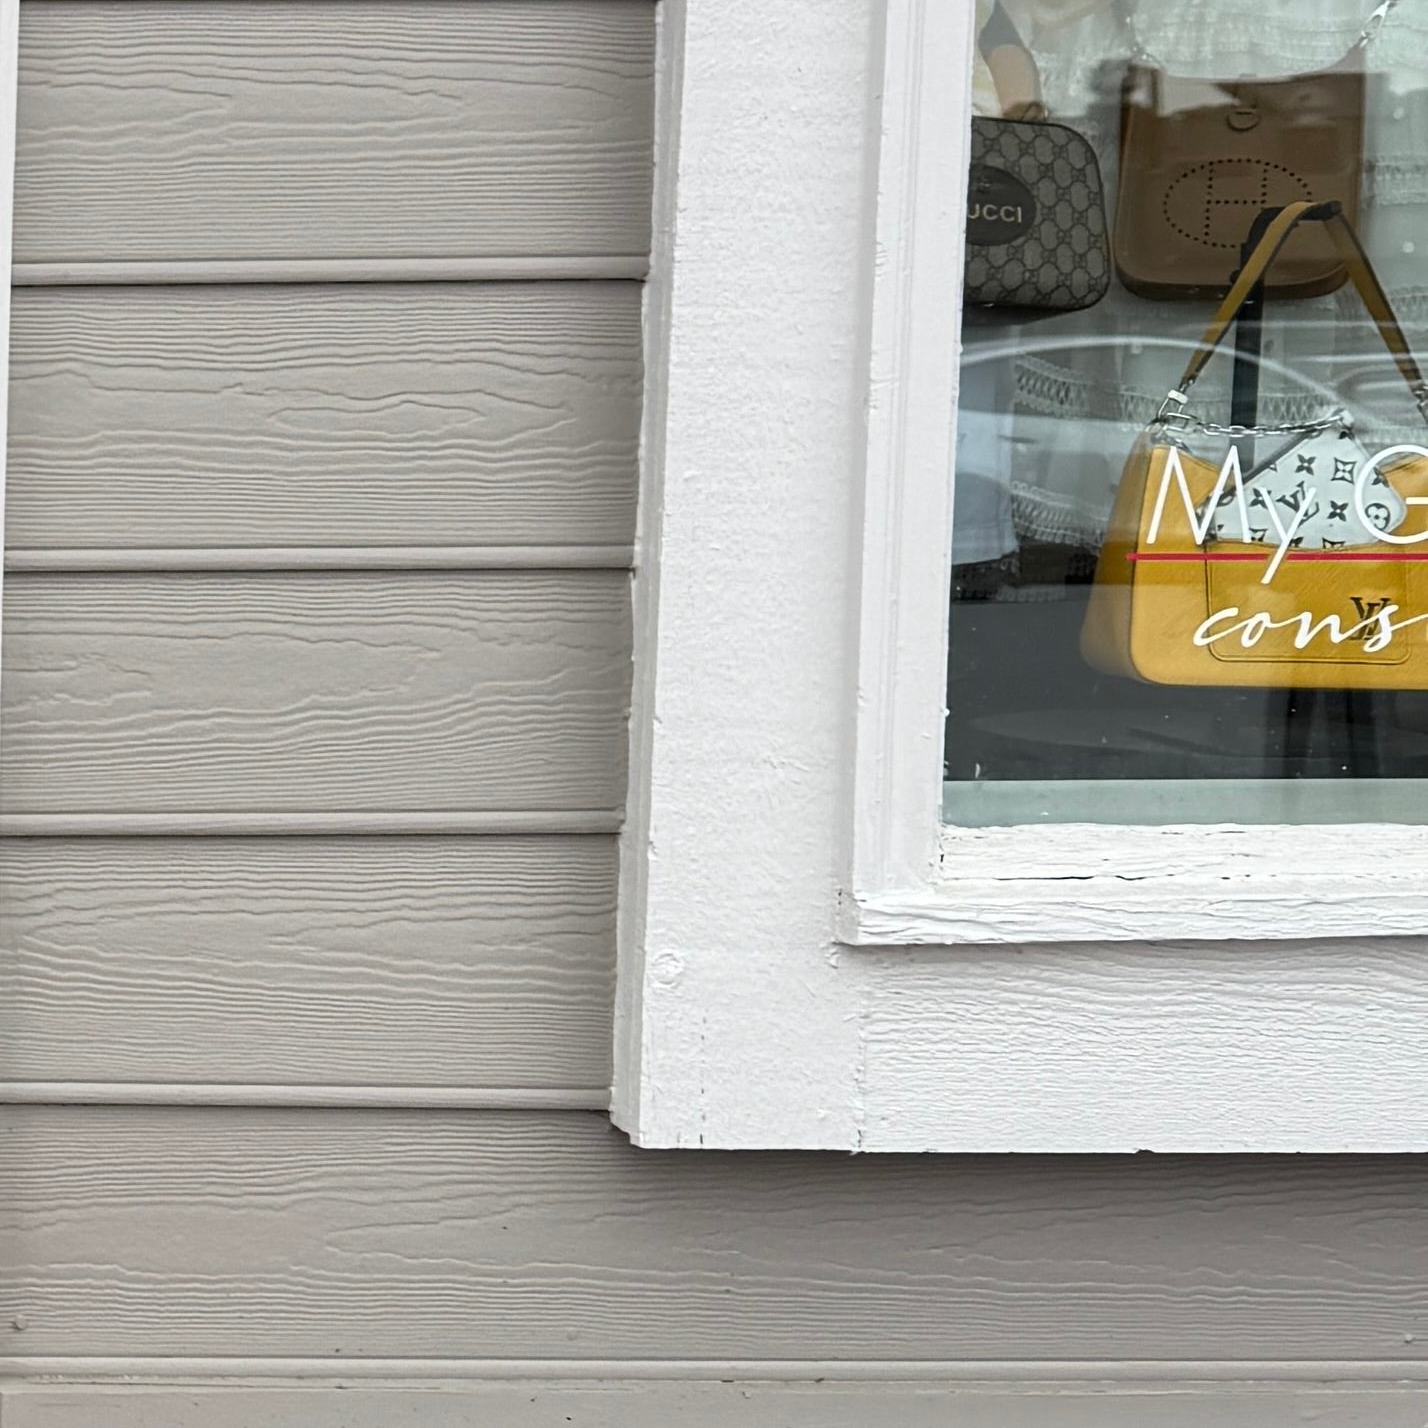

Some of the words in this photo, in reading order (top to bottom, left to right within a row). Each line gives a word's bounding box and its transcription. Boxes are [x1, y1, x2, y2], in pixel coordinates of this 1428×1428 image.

[967, 203, 1022, 223] UCCI
[1145, 445, 1318, 585] My
[1192, 604, 1428, 653] cons
